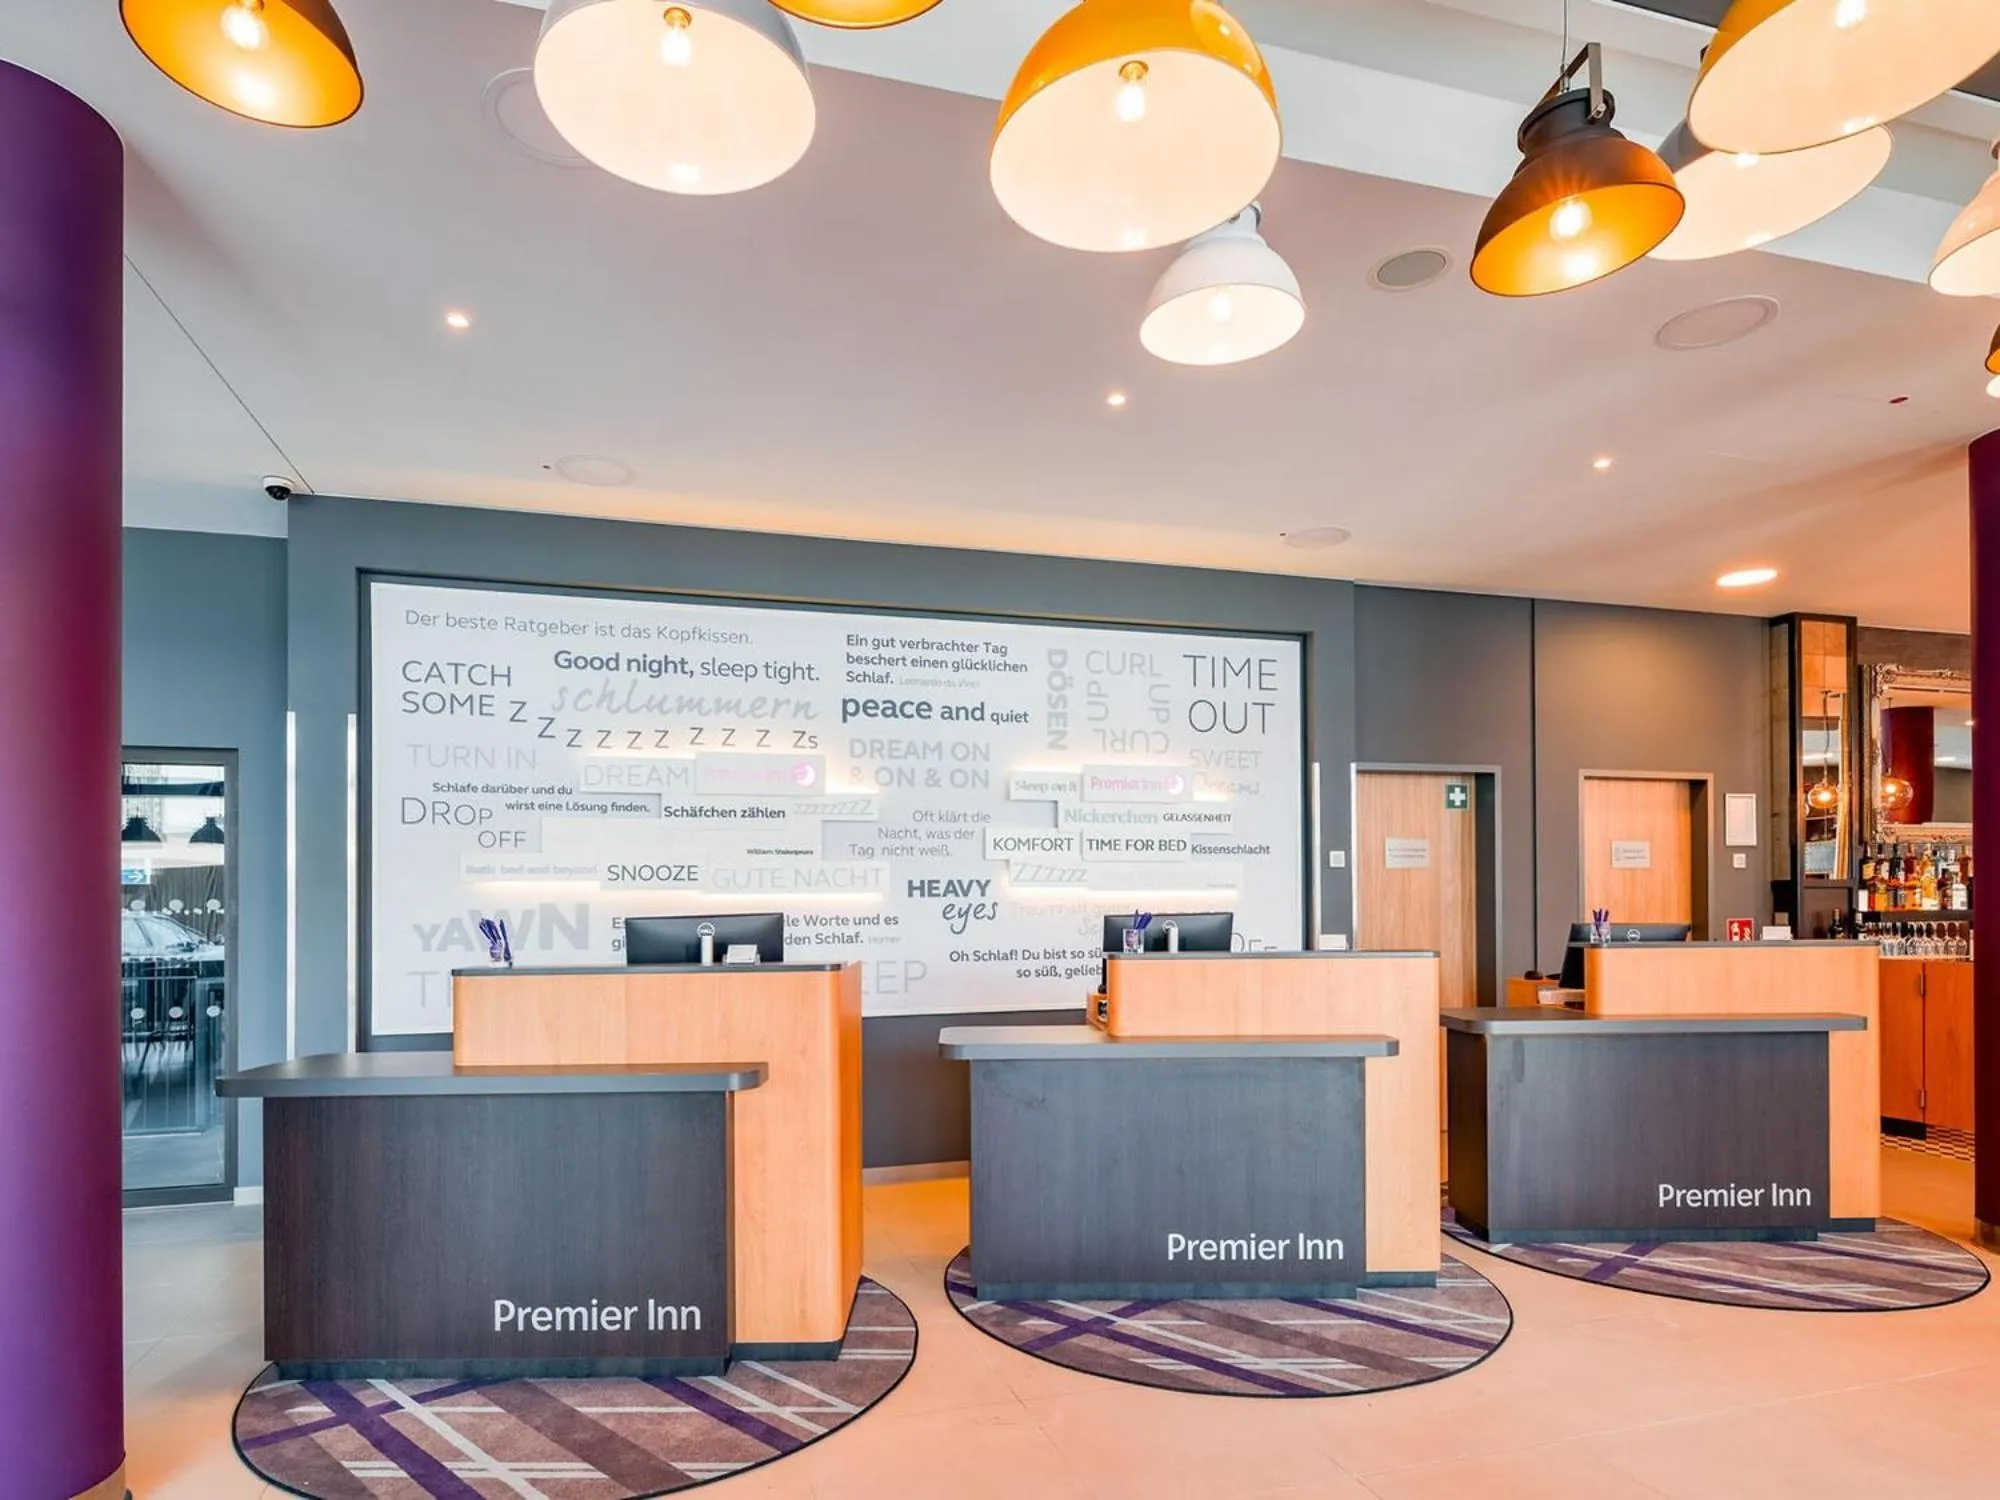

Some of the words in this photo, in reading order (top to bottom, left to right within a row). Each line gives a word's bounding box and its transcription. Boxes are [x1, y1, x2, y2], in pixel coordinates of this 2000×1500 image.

[405, 610, 438, 627] Der
[446, 613, 498, 630] beste
[505, 617, 588, 637] Ratgeber
[595, 622, 615, 637] ist
[621, 623, 651, 639] das
[656, 626, 753, 645] Kopfkissen.
[847, 635, 868, 647] Ein
[872, 637, 894, 650] gut
[900, 639, 980, 653] verbrachter
[984, 642, 1008, 657] Tag
[402, 660, 512, 687] CATCH
[554, 650, 620, 671] Good
[627, 653, 694, 678] night,
[700, 658, 758, 682] sleep
[764, 661, 820, 684] tight.
[846, 652, 907, 667] beschert
[911, 657, 948, 669] einen
[952, 659, 1028, 673] glücklichen
[1086, 650, 1162, 677] CURL
[1183, 654, 1278, 691] TIME
[846, 671, 894, 684] Schlaf.
[552, 679, 820, 721] schlummern
[841, 697, 933, 723] peace
[940, 702, 985, 721] and
[990, 710, 1030, 725] quiet
[1047, 648, 1074, 751] DÖSEN
[1149, 684, 1170, 725] UP
[401, 691, 496, 717] SOME
[509, 701, 527, 723] Z
[537, 716, 556, 739] Z
[566, 728, 583, 748] Z
[596, 729, 612, 749] Z
[626, 730, 642, 749] Z
[654, 729, 670, 749] Z
[689, 727, 704, 746] Z
[721, 728, 737, 747] Z
[755, 729, 771, 748] Z
[1188, 699, 1276, 735] OUT
[849, 738, 943, 762] DREAM
[950, 740, 990, 762] ON
[1092, 729, 1170, 755] CURL
[405, 744, 496, 769] TURN
[507, 749, 537, 770] IN
[1188, 750, 1262, 769] SWEET
[583, 764, 689, 788] DREAM
[875, 766, 916, 787] ON
[924, 768, 943, 789] &
[950, 768, 990, 789] ON
[432, 782, 478, 795] Schlafe
[481, 784, 528, 795] darüber
[531, 785, 555, 796] und
[556, 786, 573, 796] du
[400, 796, 494, 826] DROP
[505, 801, 536, 811] wirst
[537, 802, 563, 812] eine
[565, 802, 608, 814] Lösung
[611, 803, 650, 813] finden.
[663, 805, 737, 819] Schäfchen
[740, 805, 786, 819] zählen
[912, 809, 934, 823] Oft
[938, 810, 967, 823] klärt
[972, 811, 991, 824] die
[1063, 808, 1158, 825] Nickerchen
[1163, 813, 1232, 823] GELASSENHEIT
[478, 830, 526, 848] OFF
[877, 827, 922, 841] Nacht,
[925, 831, 950, 840] was
[953, 829, 975, 841] der
[992, 837, 1074, 852] KOMFORT
[1087, 838, 1122, 852] TIME
[1125, 839, 1155, 852] FOR
[1157, 839, 1187, 852] BED
[849, 843, 875, 860] Tag
[881, 845, 915, 858] nicht
[918, 847, 953, 859] weiß.
[1191, 844, 1270, 856] Kissenschlacht
[607, 864, 699, 882] SNOOZE
[711, 867, 786, 890] GUTE
[794, 867, 884, 890] NACHT
[907, 879, 991, 898] HEAVY
[412, 903, 590, 952] YAWN
[803, 915, 849, 928] Worte
[852, 914, 881, 927] und
[883, 914, 899, 926] es
[942, 901, 998, 935] eyes
[784, 933, 811, 946] den
[815, 931, 863, 945] Schlaf.
[949, 950, 969, 962] Oh
[973, 949, 1018, 962] Schlaf!
[1022, 949, 1040, 960] Du
[1043, 948, 1067, 960] bist
[1070, 950, 1085, 959] so
[1088, 946, 1103, 958] sü
[1016, 968, 1031, 978] so
[1034, 965, 1061, 978] süß,
[1658, 1183, 1765, 1207] Premier
[1772, 1183, 1812, 1207] Inn
[1167, 1233, 1290, 1261] Premier
[1298, 1232, 1344, 1260] Inn
[494, 1299, 639, 1332] Premier
[648, 1298, 701, 1331] Inn
